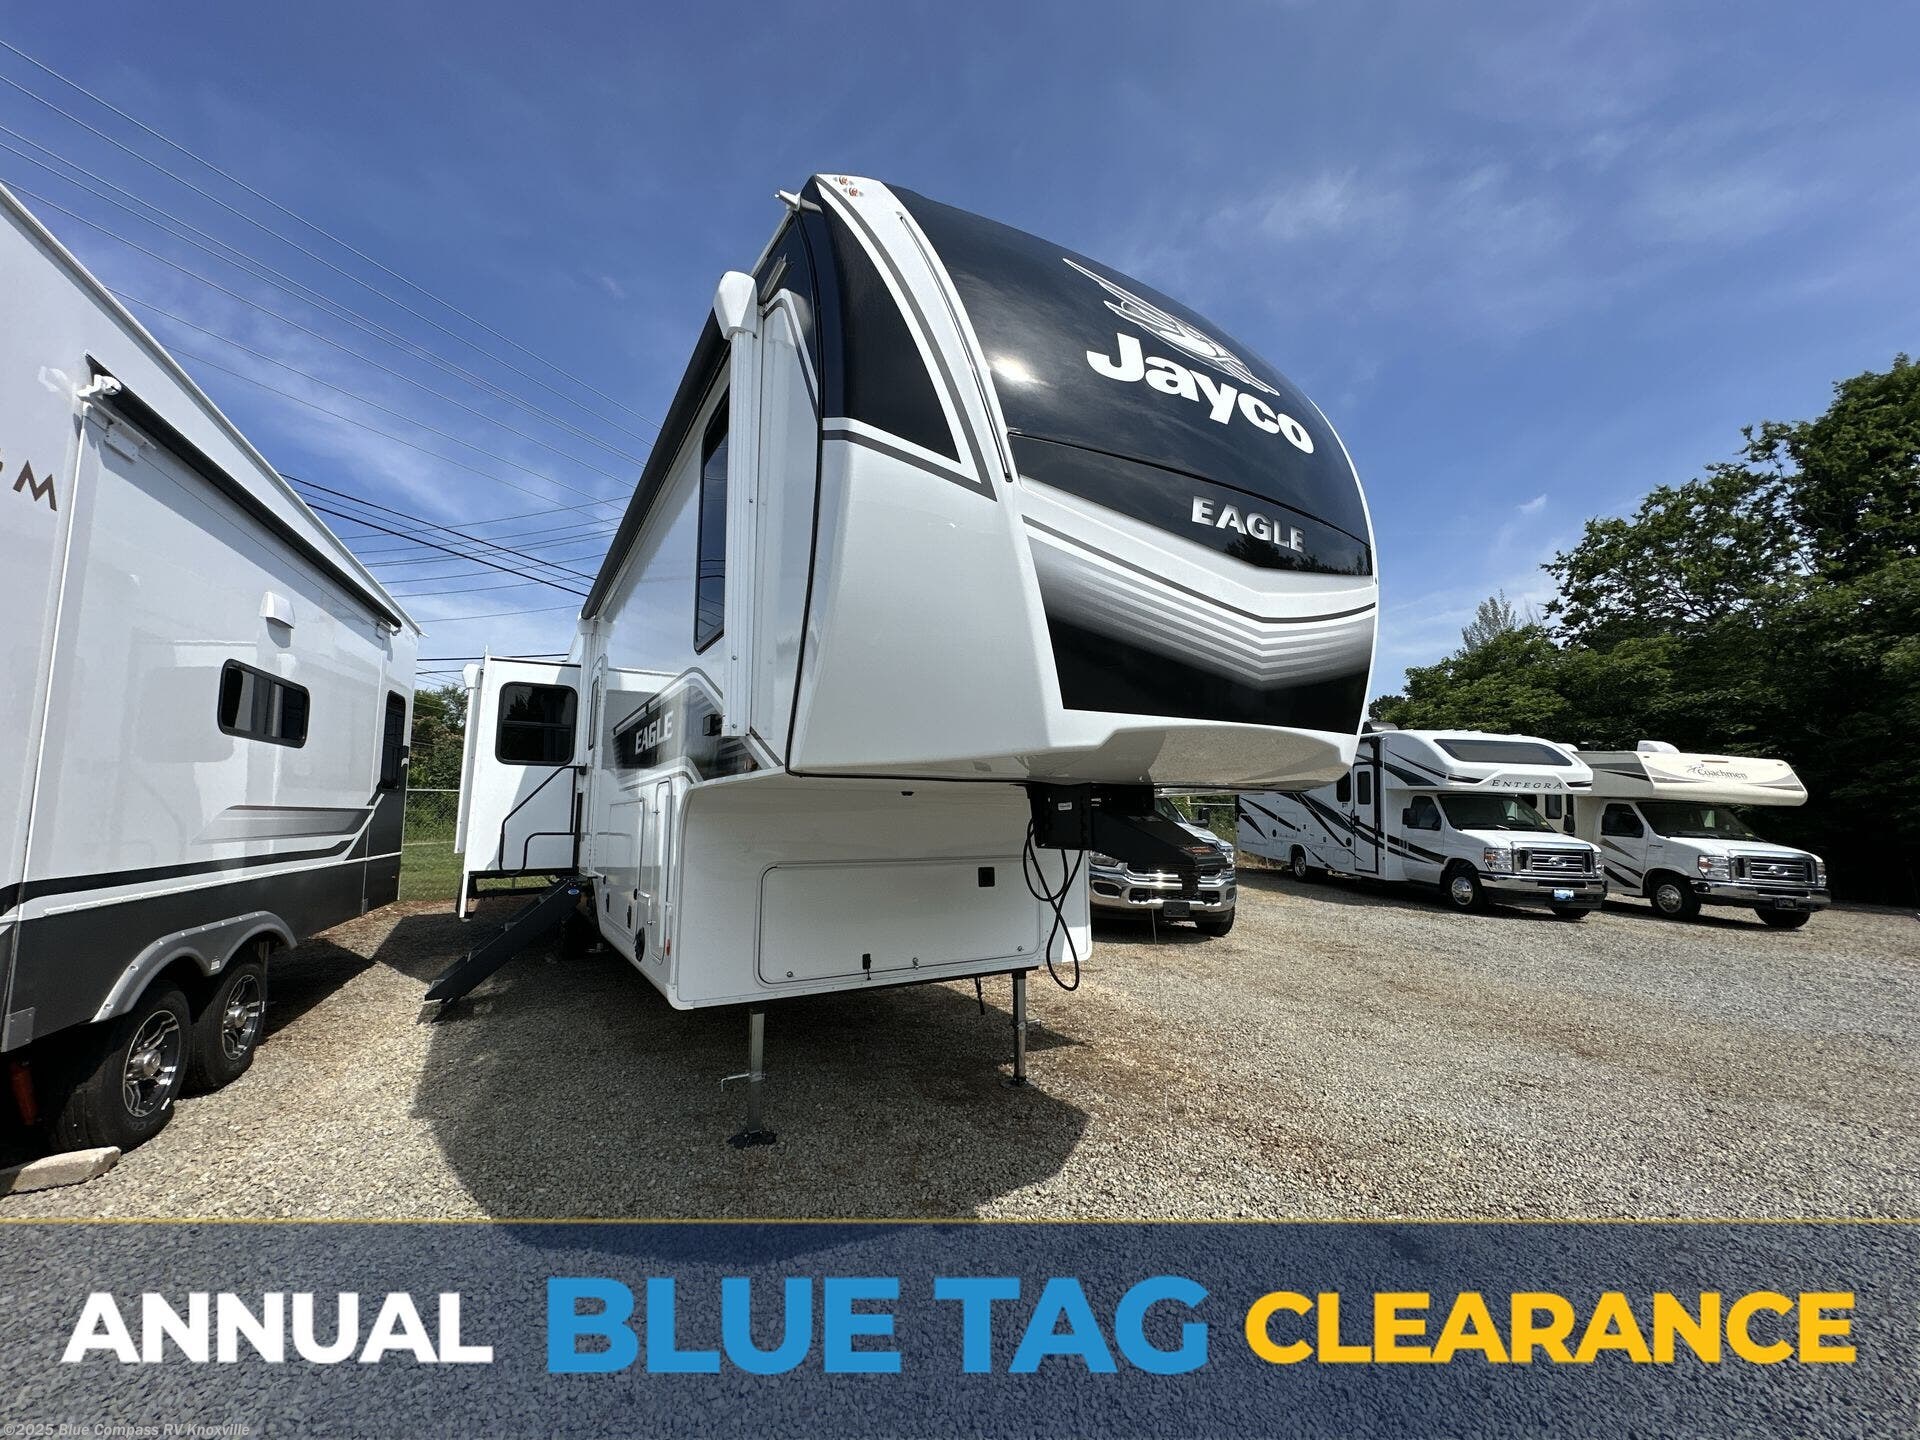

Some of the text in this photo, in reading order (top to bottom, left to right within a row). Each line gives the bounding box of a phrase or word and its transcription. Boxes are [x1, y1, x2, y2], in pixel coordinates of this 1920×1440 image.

[1086, 332, 1314, 454] Jayco
[1191, 495, 1305, 553] EAGLE
[634, 710, 674, 755] EAGLE
[1491, 779, 1563, 790] ENTEGRA
